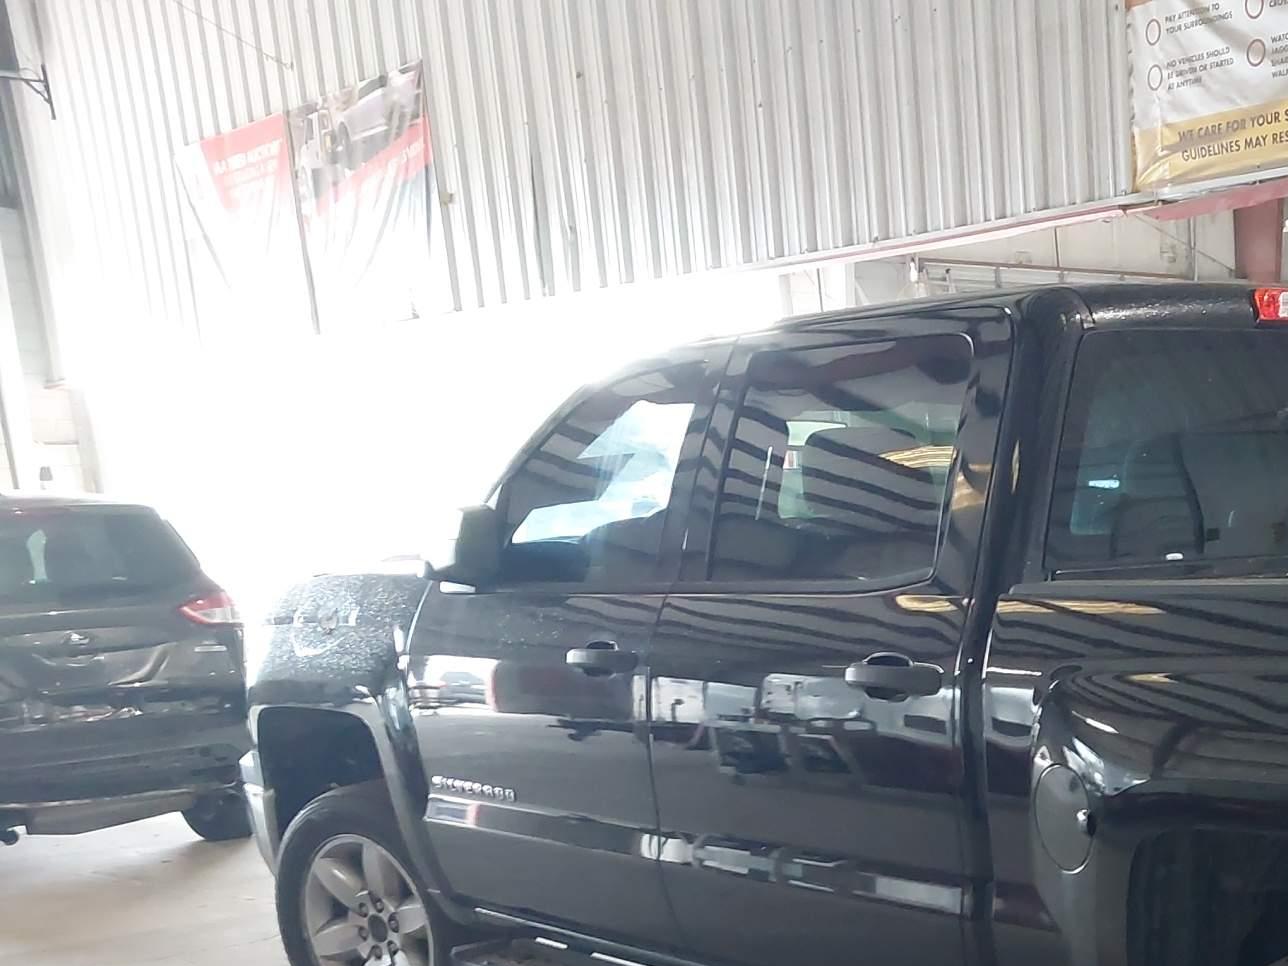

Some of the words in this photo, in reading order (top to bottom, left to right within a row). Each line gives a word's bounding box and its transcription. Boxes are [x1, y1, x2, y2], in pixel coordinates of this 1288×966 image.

[1212, 3, 1220, 11] TO
[1166, 24, 1182, 34] YOUR
[1167, 60, 1177, 69] NO
[1206, 46, 1230, 58] SHOULD
[1199, 64, 1207, 72] OR
[1210, 57, 1234, 69] STARTED
[1178, 130, 1193, 143] WE
[1195, 123, 1223, 139] CARE
[1226, 118, 1247, 134] FOR
[1250, 111, 1281, 128] YOUR
[1181, 139, 1241, 162] GUIDELINES
[1244, 134, 1268, 150] MAY
[431, 775, 515, 801] SILVERADO
